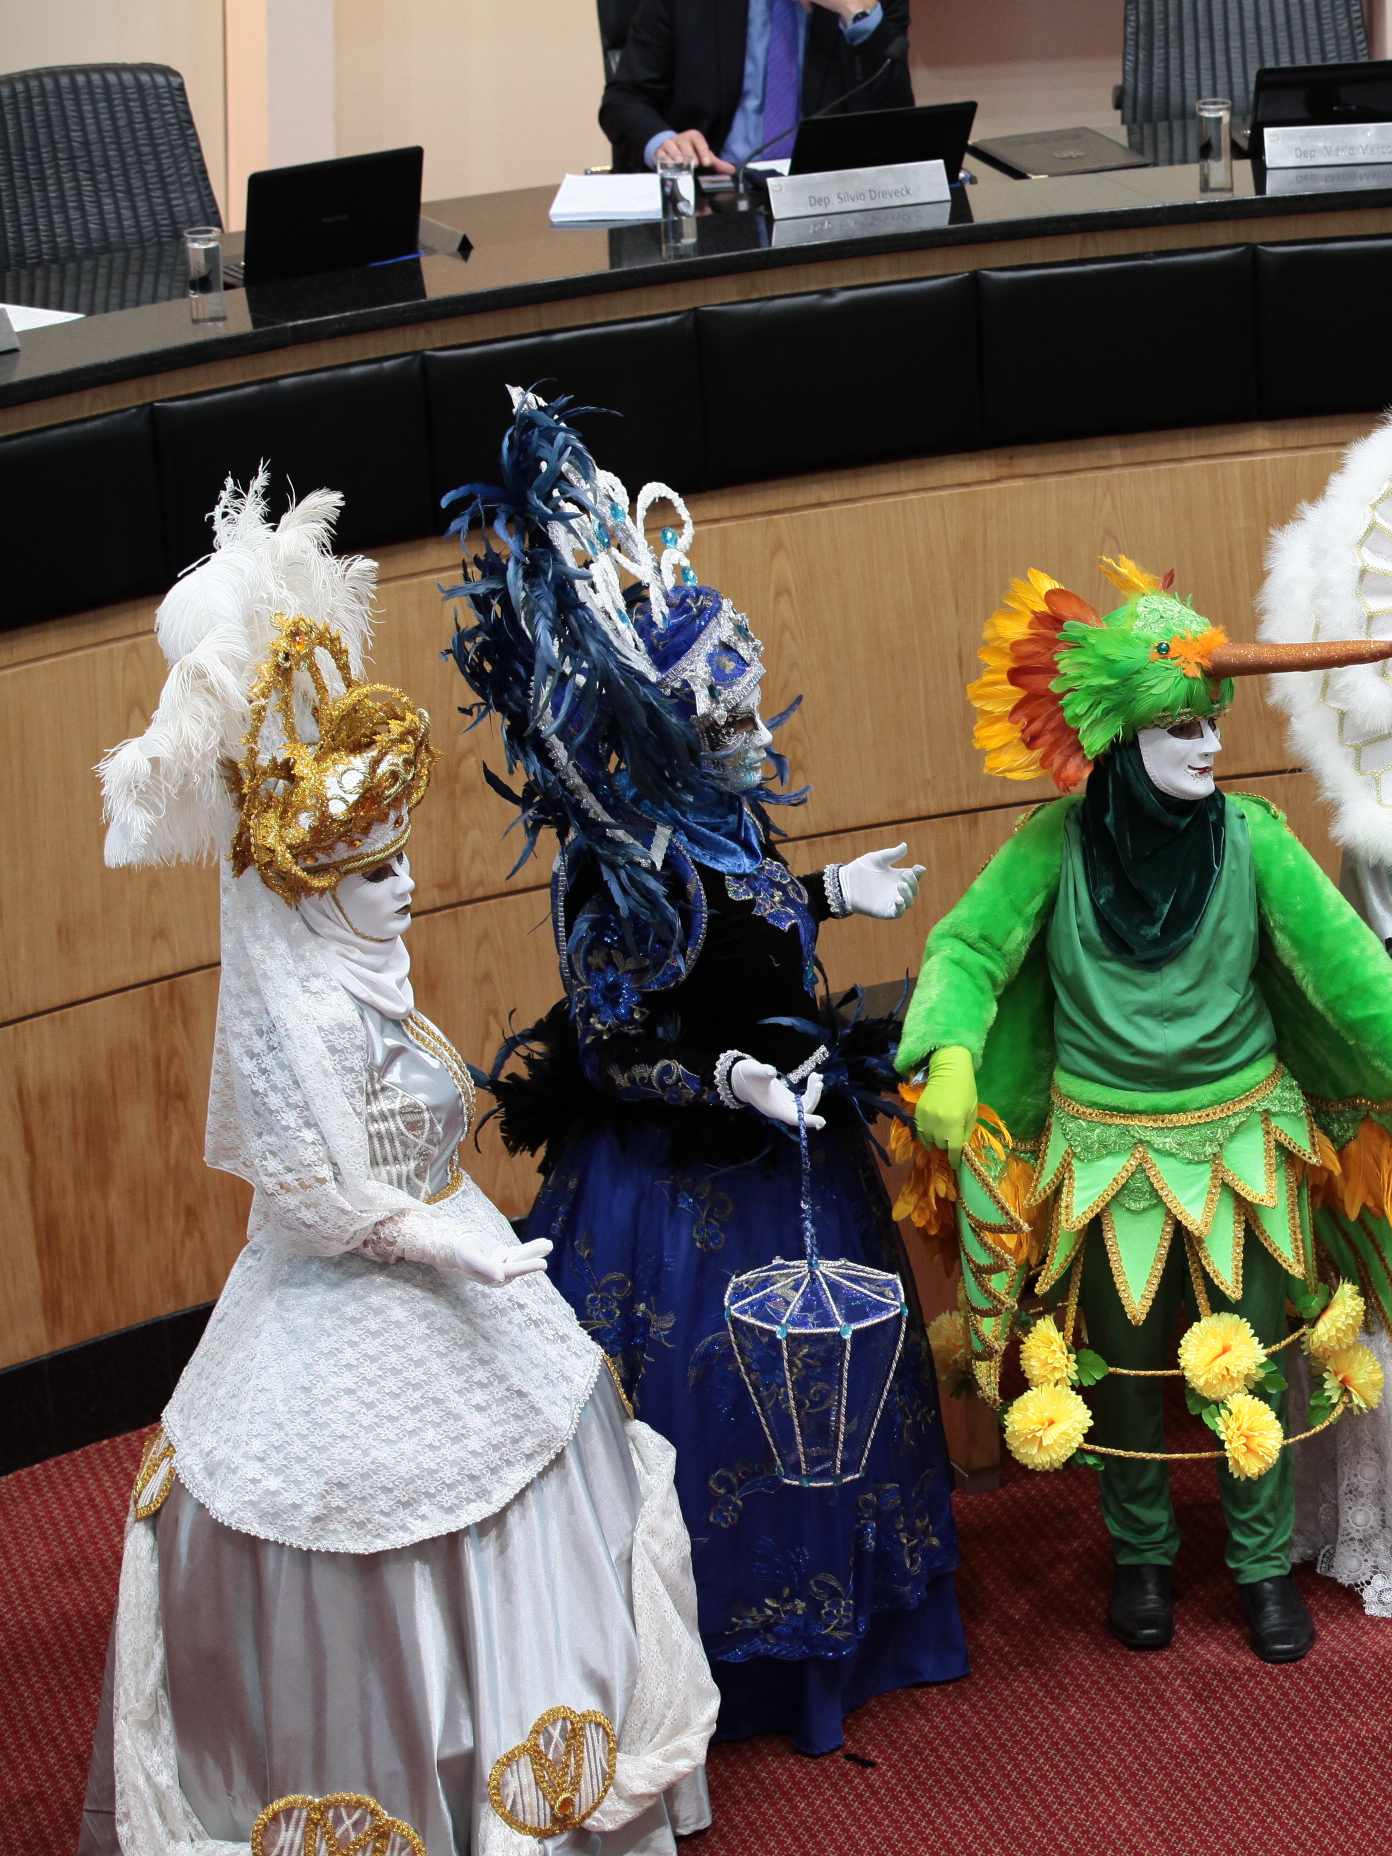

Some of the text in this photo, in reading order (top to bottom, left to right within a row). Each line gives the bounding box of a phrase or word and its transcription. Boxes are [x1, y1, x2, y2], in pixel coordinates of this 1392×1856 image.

[809, 185, 912, 208] Dep. Silvio Dreveck
